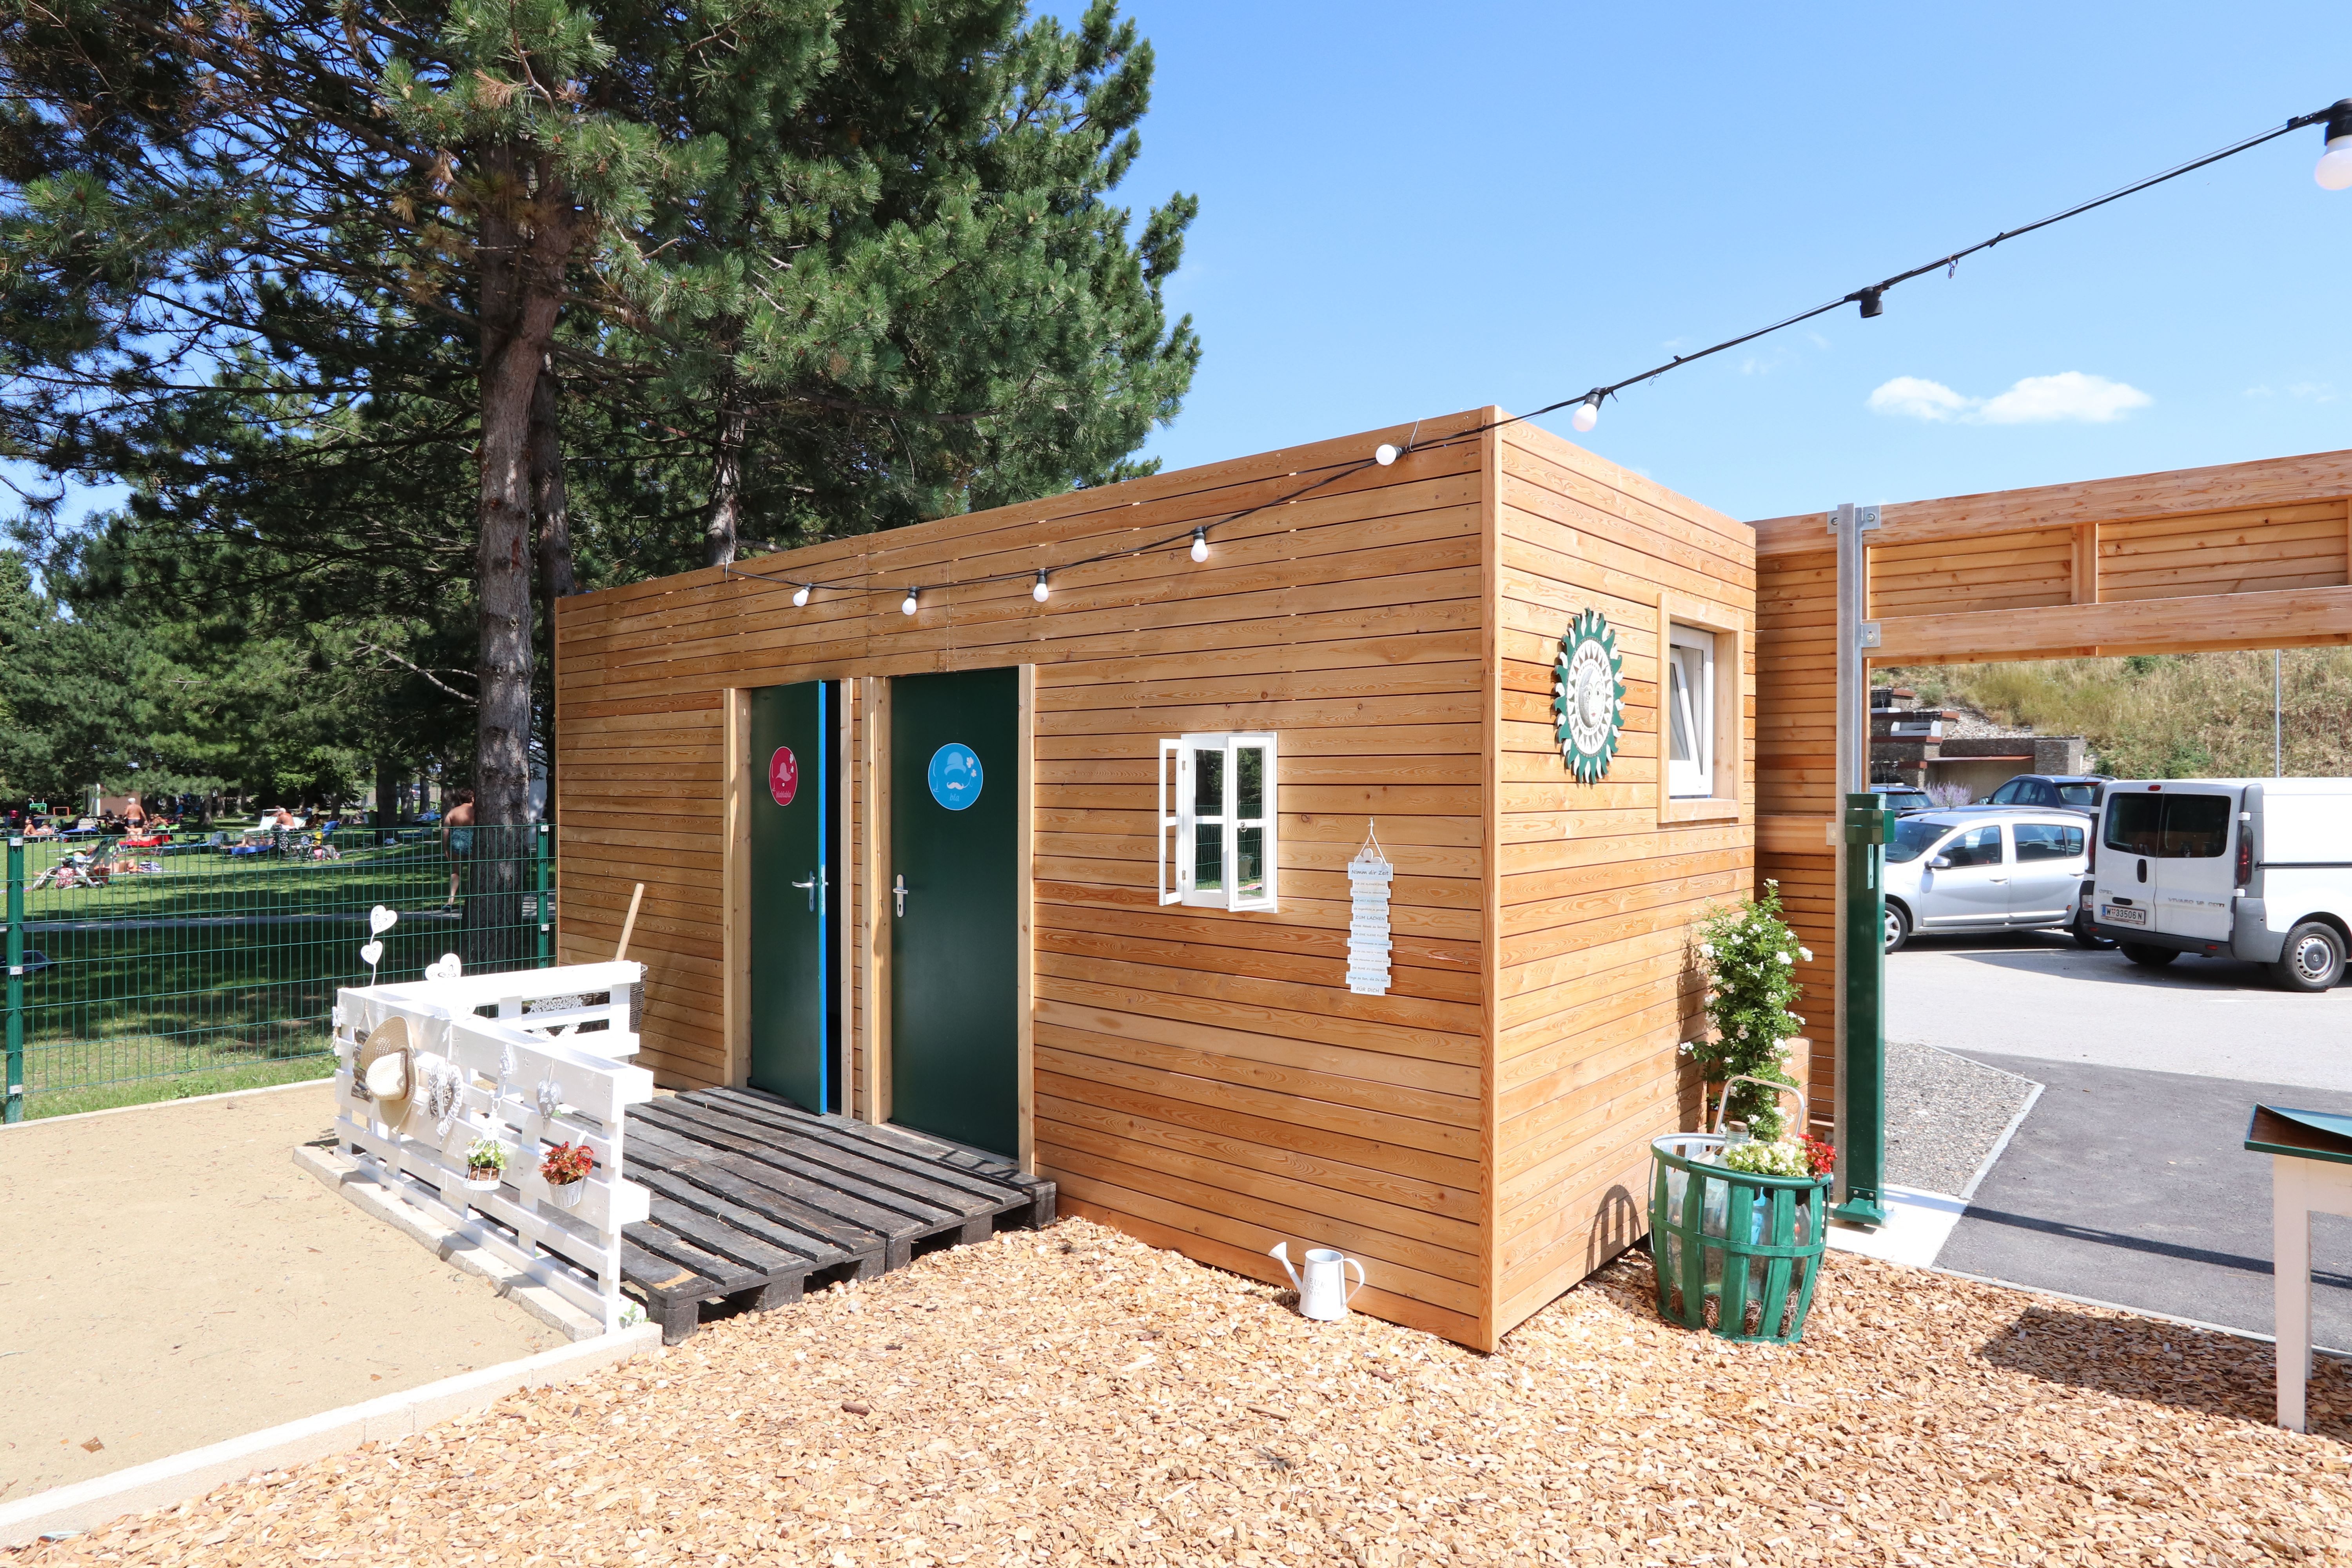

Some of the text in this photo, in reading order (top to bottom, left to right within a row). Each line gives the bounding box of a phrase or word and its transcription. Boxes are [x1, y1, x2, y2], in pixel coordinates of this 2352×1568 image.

[949, 793, 959, 801] bla
[2116, 909, 2136, 919] 33506
[1304, 1286, 1320, 1296] PARIS
